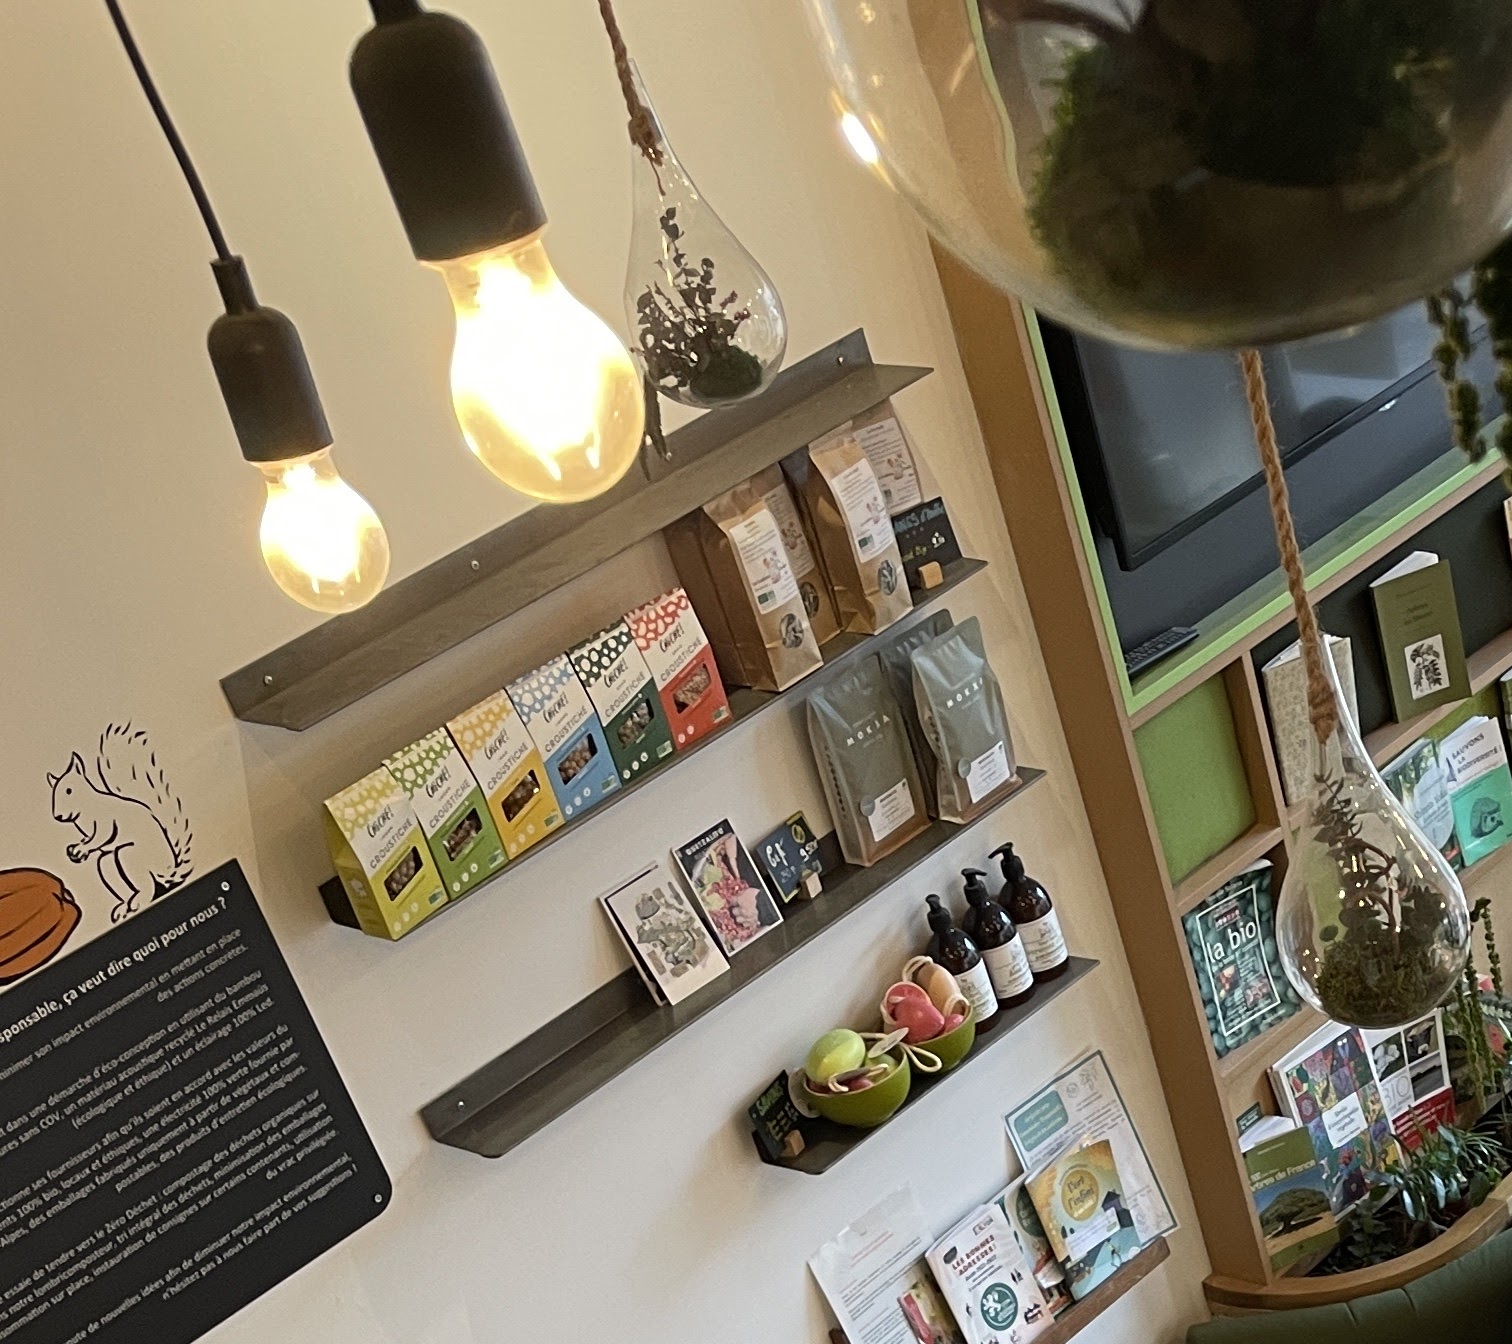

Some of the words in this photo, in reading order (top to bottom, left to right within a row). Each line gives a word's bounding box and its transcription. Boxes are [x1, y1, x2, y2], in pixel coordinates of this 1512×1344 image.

[1452, 732, 1485, 759] SAUVONS
[62, 988, 79, 1006] ça
[77, 970, 107, 993] veut
[106, 956, 132, 977] dire
[132, 936, 161, 962] quoi
[159, 921, 188, 948] pour
[189, 904, 219, 927] nous
[1207, 942, 1225, 963] la
[1227, 921, 1257, 949] bio
